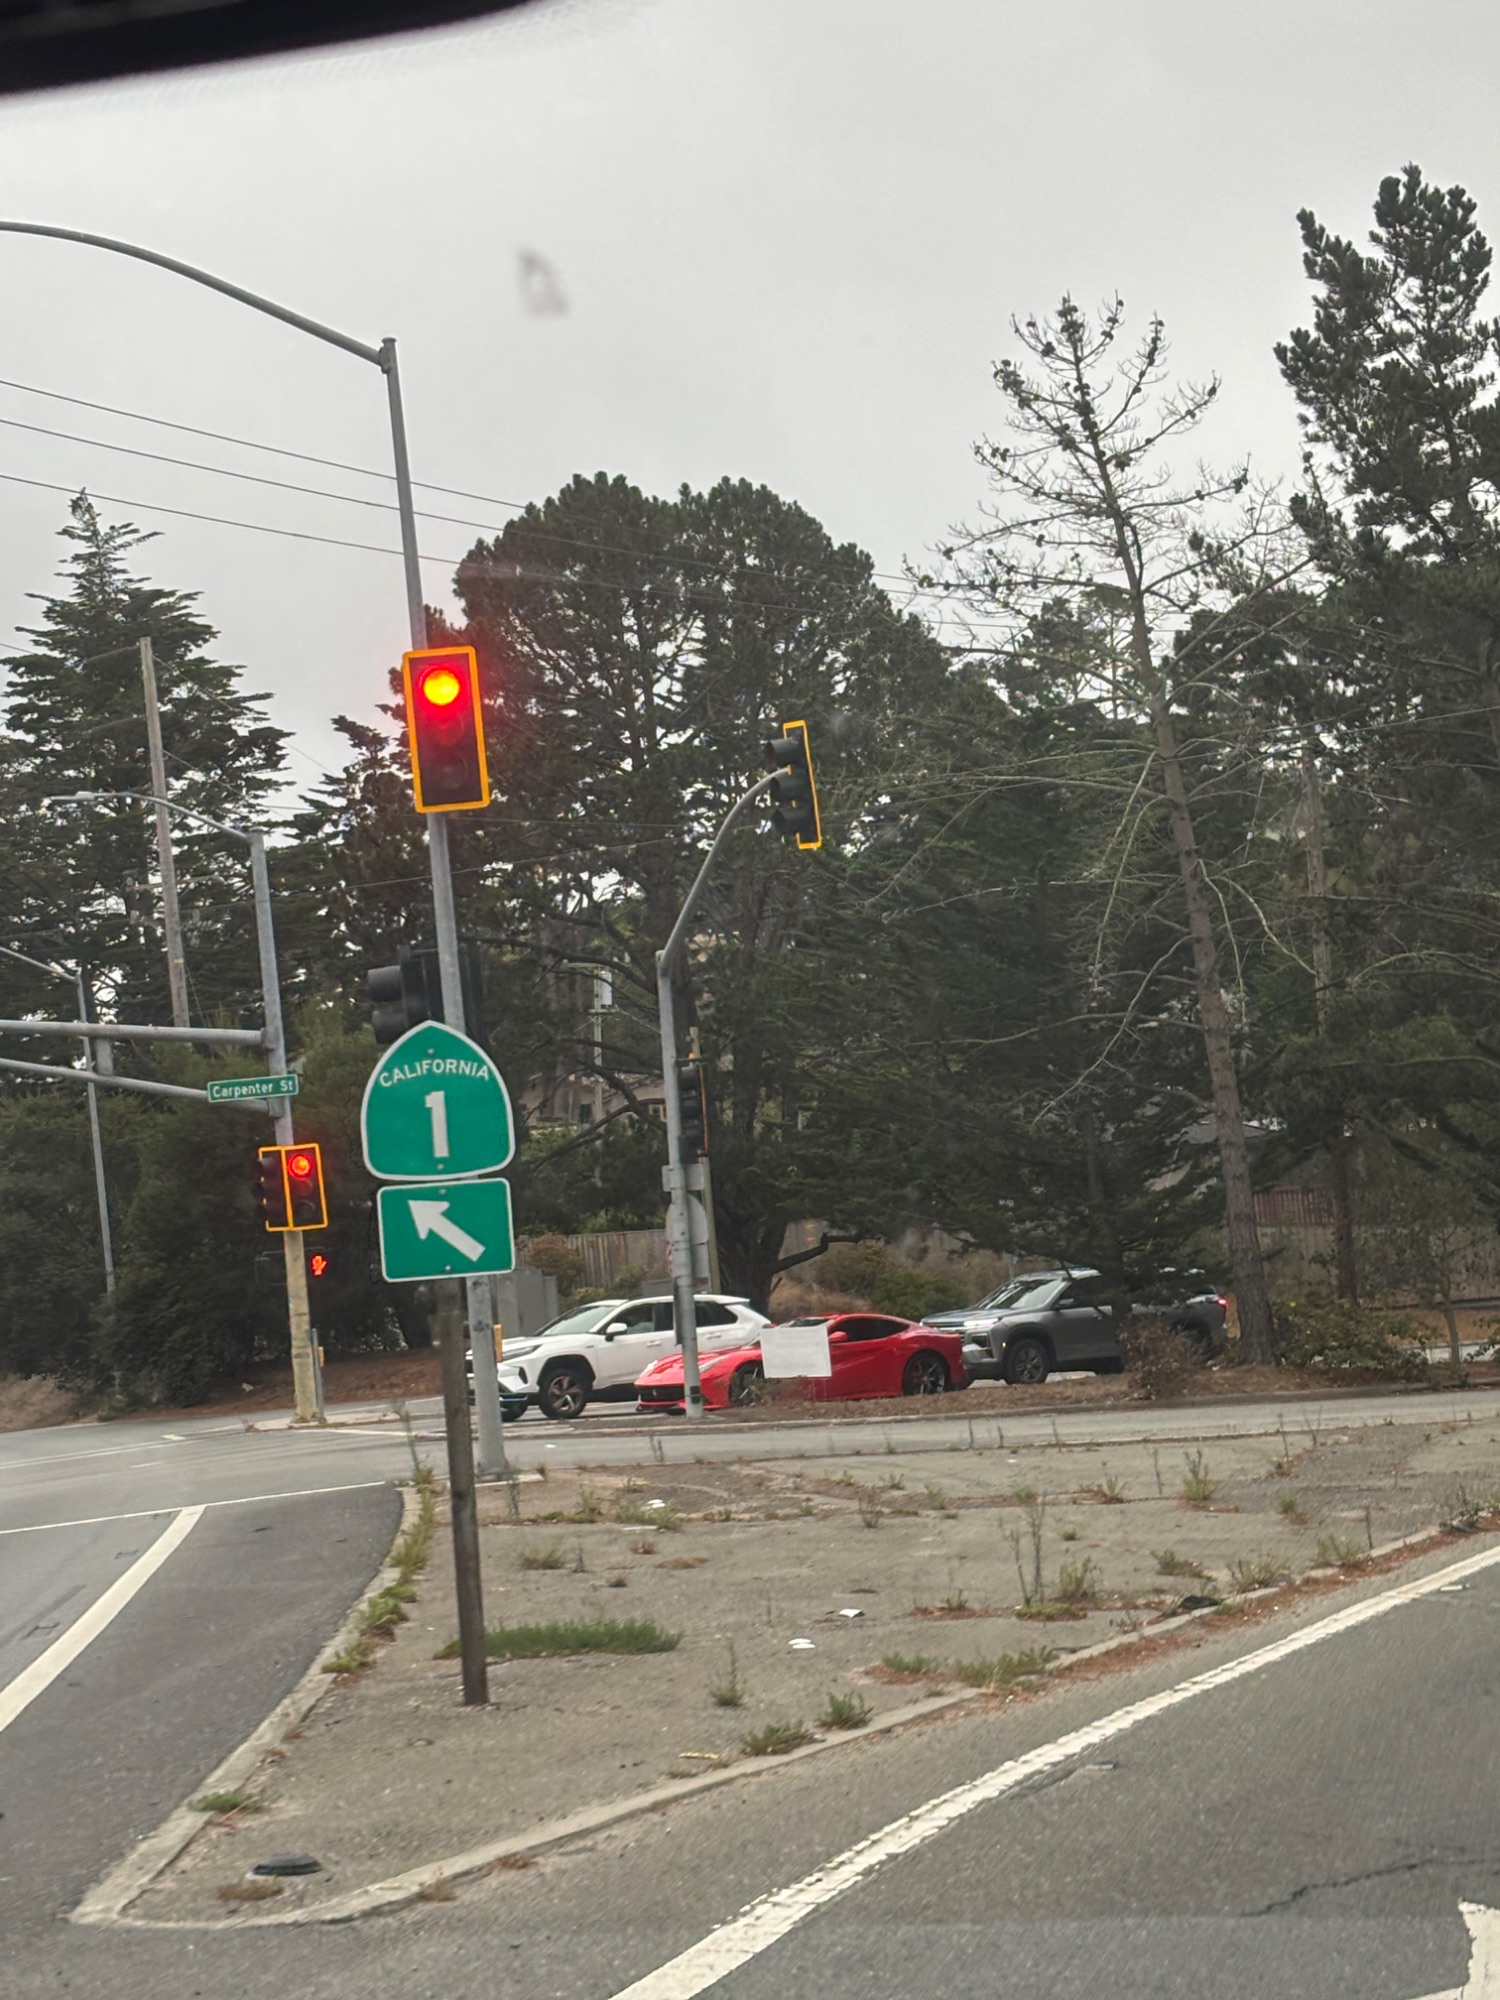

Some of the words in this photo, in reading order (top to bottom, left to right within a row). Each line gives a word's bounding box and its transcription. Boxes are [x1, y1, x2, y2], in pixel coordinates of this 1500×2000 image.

[379, 1058, 490, 1087] CALIFORNIA
[212, 1083, 273, 1098] Carpenter
[279, 1080, 294, 1091] St
[424, 1090, 450, 1158] 1
